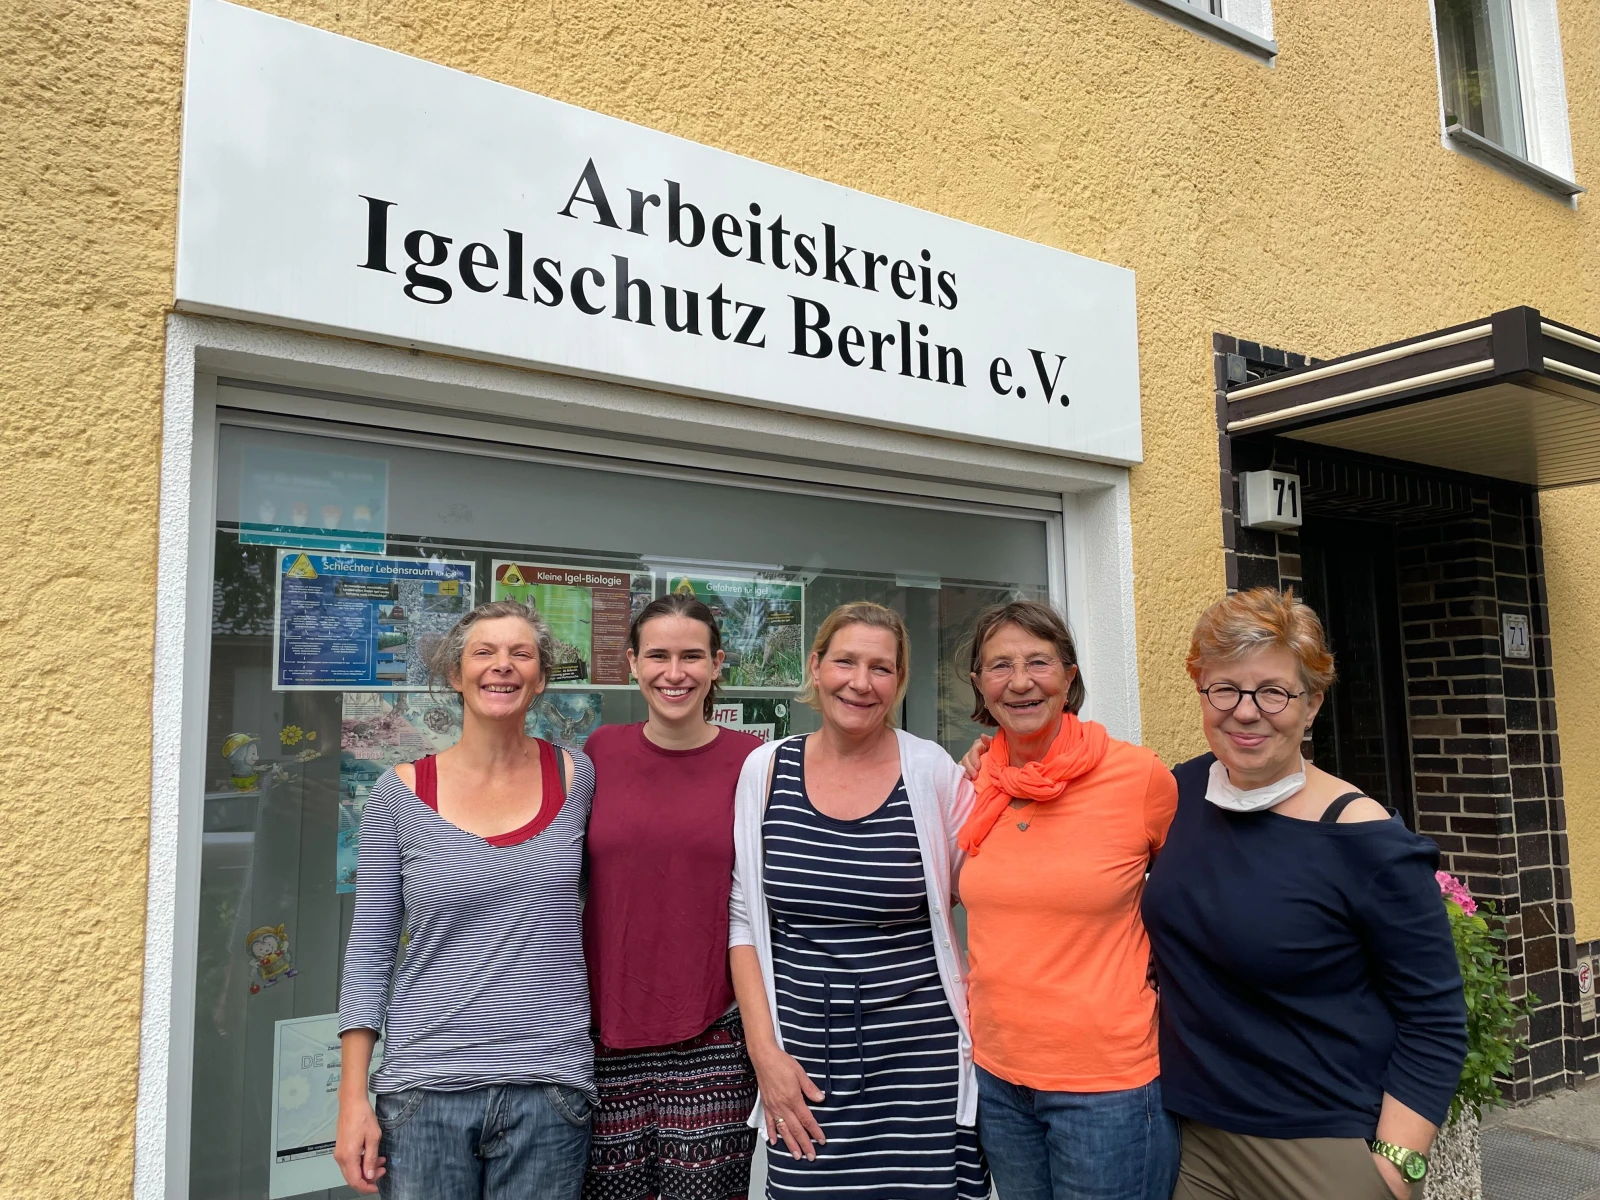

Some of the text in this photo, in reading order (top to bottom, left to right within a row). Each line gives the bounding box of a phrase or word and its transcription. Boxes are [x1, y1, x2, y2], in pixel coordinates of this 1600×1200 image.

[557, 157, 958, 310] Arbeitskreis
[357, 195, 1070, 407] Igelschutz Berlin e.V.
[1273, 478, 1297, 518] 71
[323, 561, 373, 574] Schlechter
[376, 564, 433, 576] Lebensraum
[537, 572, 622, 586] Kleine Igel-Biologie
[706, 583, 742, 594] Gefahren
[755, 587, 768, 597] Igel
[1510, 626, 1524, 645] 71
[301, 1053, 324, 1070] DE
